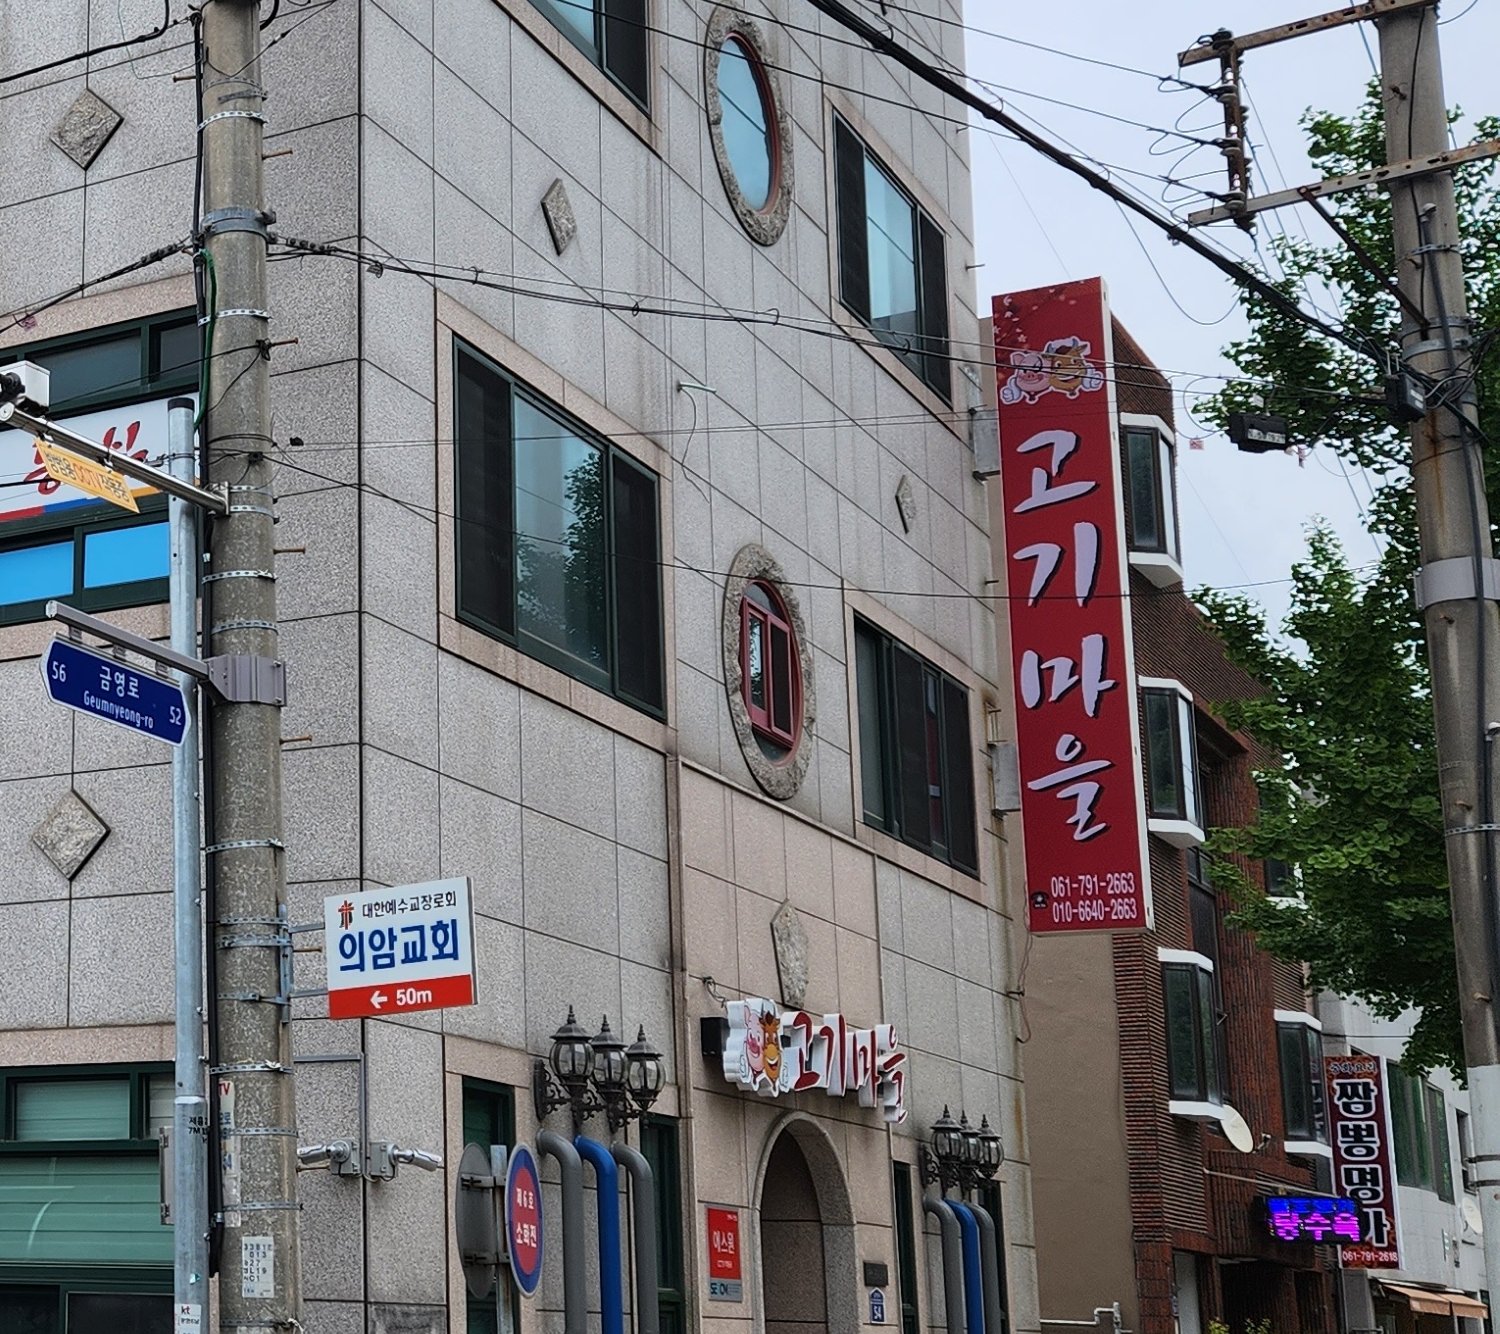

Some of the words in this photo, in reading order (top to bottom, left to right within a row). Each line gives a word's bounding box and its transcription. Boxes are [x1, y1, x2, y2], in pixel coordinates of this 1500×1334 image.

[71, 463, 103, 491] CCTV
[1013, 429, 1117, 841] 고기마을
[52, 661, 67, 683] 56
[99, 665, 140, 700] 금영로
[83, 689, 154, 729] Geumnyeong-ro
[169, 705, 183, 726] 52
[1049, 872, 1136, 899] 061-791-2663
[362, 890, 458, 919] 대한예수교장로회
[1051, 896, 1138, 924] 010-6640-2663
[338, 918, 460, 973] 의암교회
[396, 987, 433, 1006] 50m
[792, 1011, 909, 1124] 고기마을
[1329, 1061, 1379, 1074] 중화요리
[515, 1221, 537, 1248] 소화전
[712, 1230, 736, 1255] 에스원
[1341, 1250, 1399, 1263] 061-791-2618
[180, 1305, 191, 1315] kt
